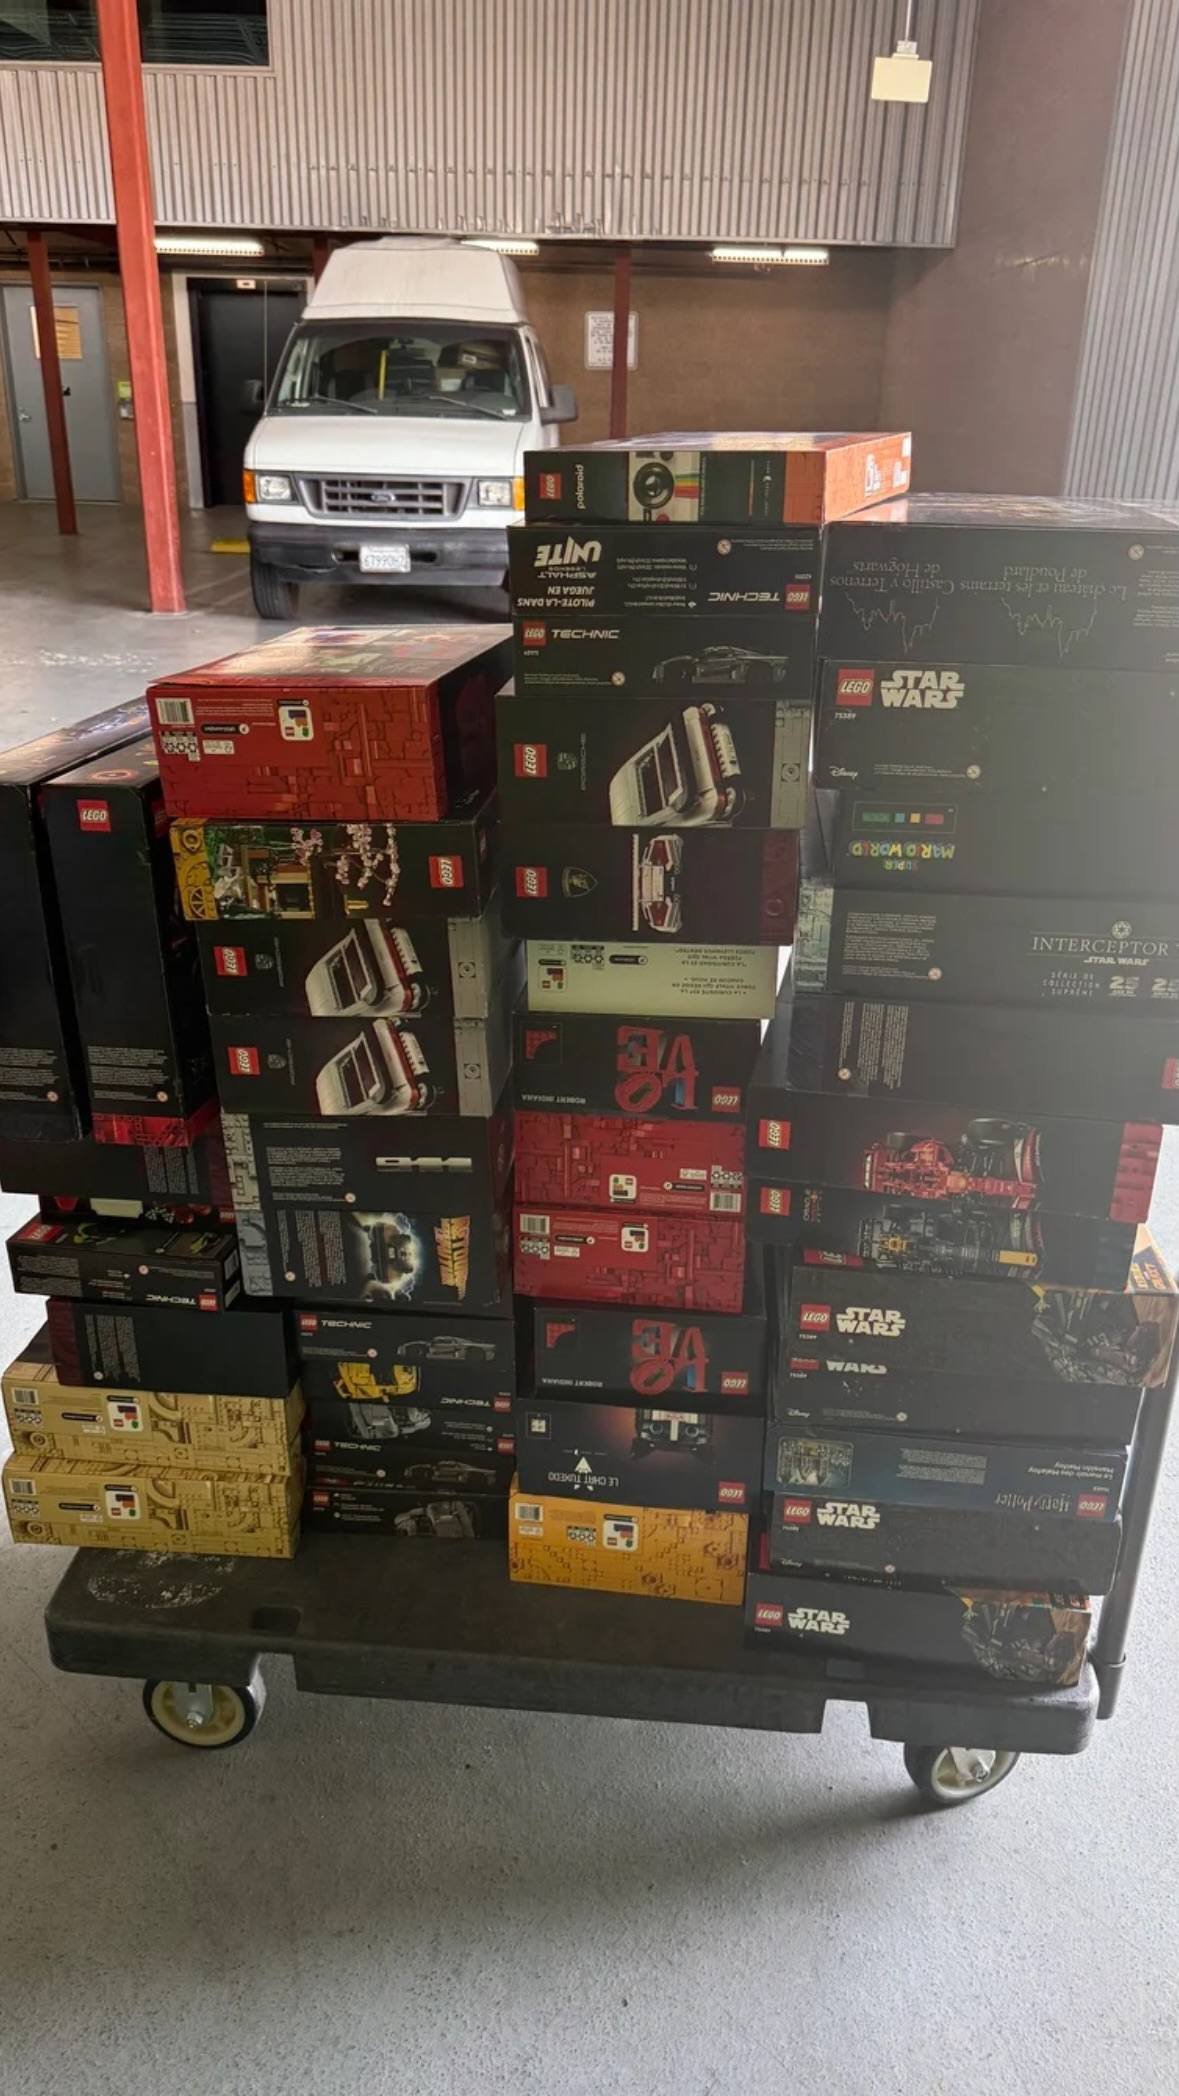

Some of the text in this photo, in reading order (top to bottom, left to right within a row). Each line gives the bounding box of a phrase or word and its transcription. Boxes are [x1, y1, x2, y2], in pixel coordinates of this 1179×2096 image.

[575, 464, 586, 509] polaroid
[534, 535, 602, 567] UNITE
[925, 564, 940, 578] de
[1003, 566, 1087, 582] de Poudlard
[547, 586, 595, 595] JUEGA EN
[829, 576, 888, 592] Terrenos
[902, 577, 955, 595] Castillo
[959, 579, 1012, 594] terrains
[1016, 583, 1031, 598] les
[517, 598, 596, 608] PILOTE-LA DANS
[707, 592, 781, 602] TECHNIC
[551, 629, 621, 639] TECHNIC
[881, 669, 965, 690] STAR
[839, 680, 873, 695] LEGO
[881, 688, 965, 710] WARS
[525, 746, 537, 776] LEGO
[829, 765, 858, 780] Disney
[81, 809, 107, 822] LEGO
[849, 840, 955, 861] MARIO WORLD
[439, 857, 453, 885] LEGO
[525, 868, 538, 895] LEGO
[1032, 936, 1169, 957] INTERCEPTOR
[223, 949, 237, 975] LEGO
[1083, 956, 1150, 966] STAR WARS
[237, 1049, 250, 1074] LEGO
[713, 1093, 738, 1105] LEGO
[768, 1122, 781, 1146] LEGO
[770, 1189, 782, 1213] LEGO
[146, 1294, 196, 1305] TECHNIC
[803, 1311, 828, 1322] LEGO
[836, 1307, 906, 1324] STAR
[321, 1320, 372, 1329] TECHNIC
[836, 1319, 906, 1337] WARS
[826, 1360, 887, 1374] WARS
[722, 1378, 746, 1388] LEGO
[440, 1397, 490, 1407] TECHNIC
[547, 1472, 619, 1487] LE CHAT TUXEDO
[719, 1488, 743, 1498] LEGO
[995, 1490, 1070, 1513] Harry Potter
[1080, 1501, 1105, 1512] LEGO
[785, 1506, 811, 1517] LEGO
[817, 1502, 880, 1518] STAR
[817, 1513, 880, 1529] WARS
[758, 1609, 781, 1619] LEGO
[788, 1607, 850, 1624] STAR
[788, 1617, 850, 1635] WARS
